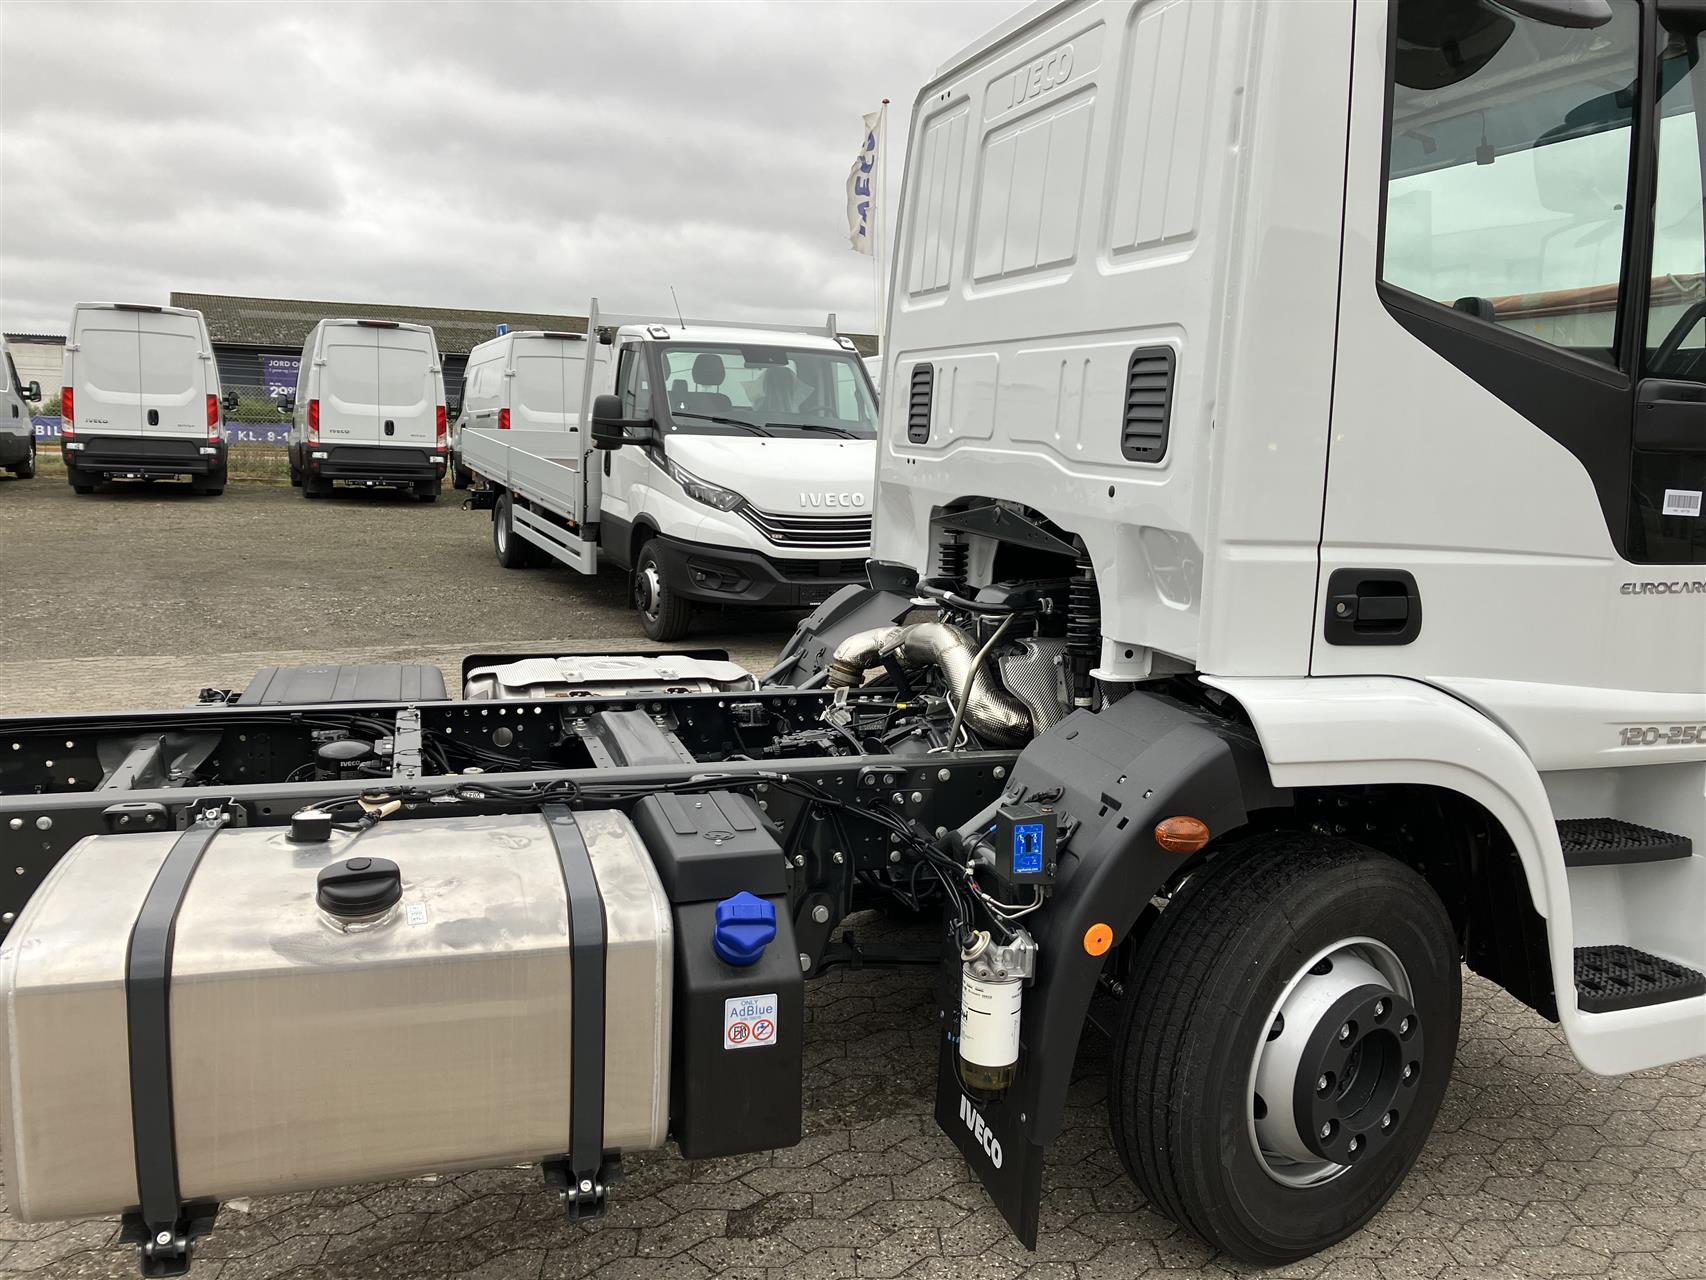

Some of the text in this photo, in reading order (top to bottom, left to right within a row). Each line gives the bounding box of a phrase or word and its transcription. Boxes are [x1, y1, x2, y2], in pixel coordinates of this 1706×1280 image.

[1007, 44, 1074, 109] IVECO
[800, 492, 865, 508] IVECO
[730, 1005, 773, 1018] AdBlue
[960, 1093, 1003, 1169] IVECO
